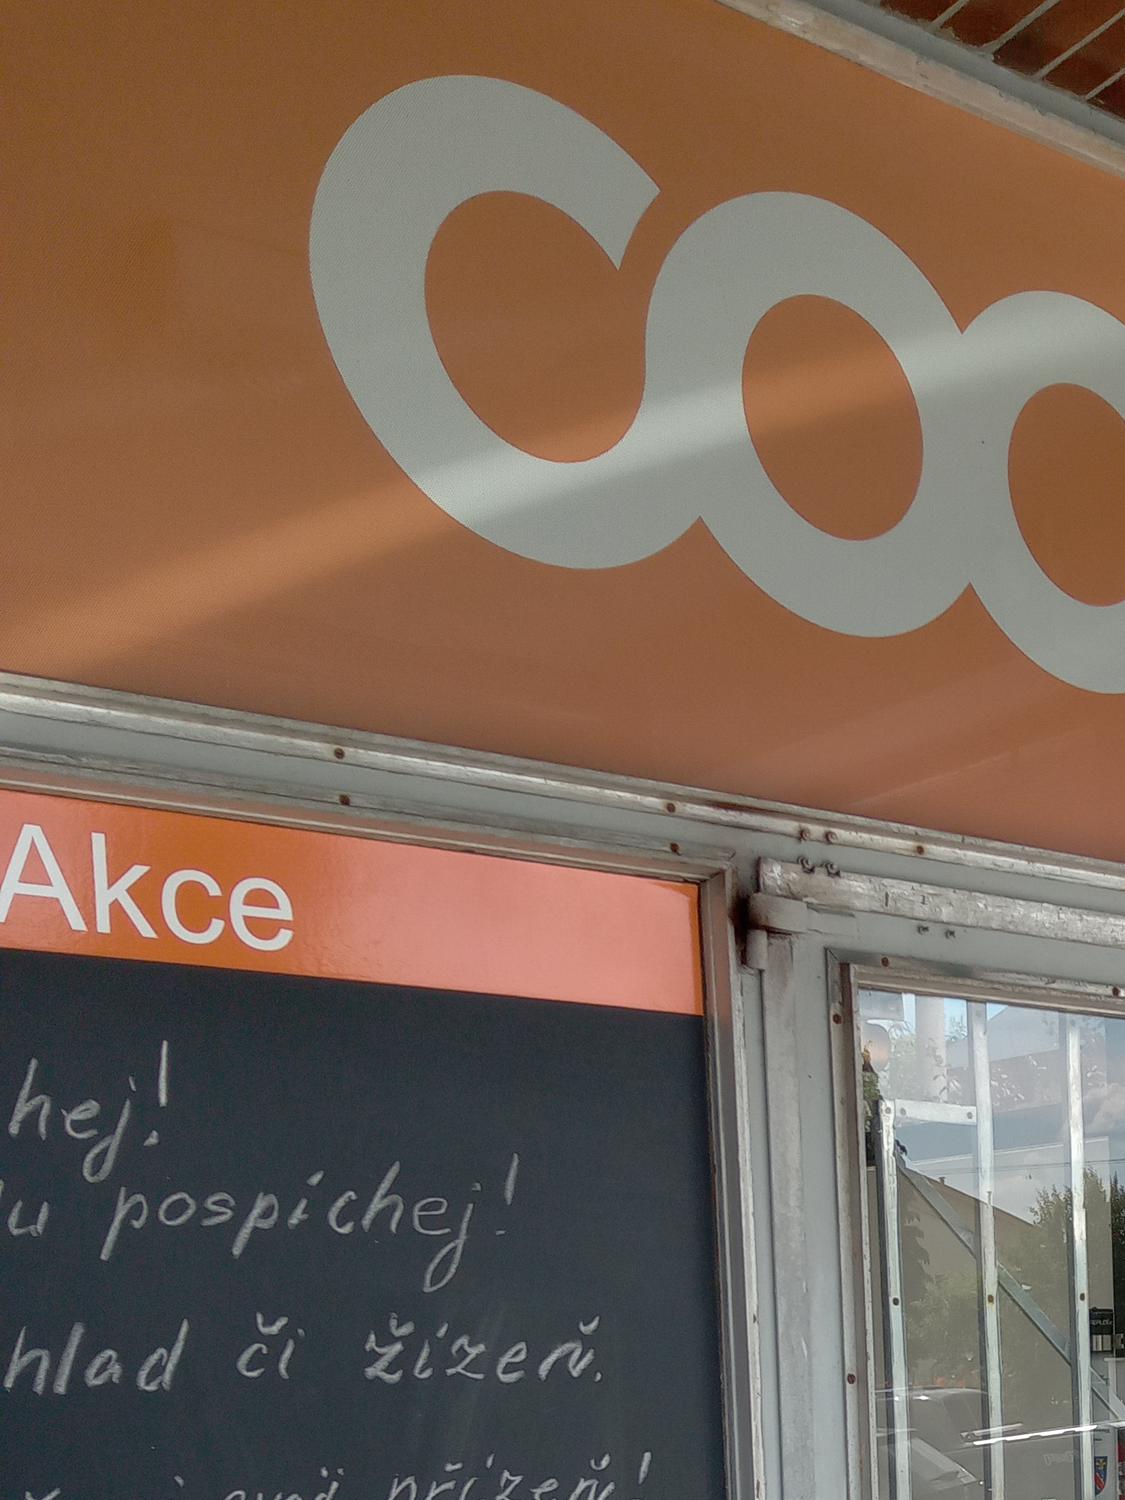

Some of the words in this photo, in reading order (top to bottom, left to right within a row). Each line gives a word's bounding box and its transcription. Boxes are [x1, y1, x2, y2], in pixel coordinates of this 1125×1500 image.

[0, 823, 295, 952] Akce
[2, 1317, 190, 1396] hlad
[236, 1312, 304, 1381] či
